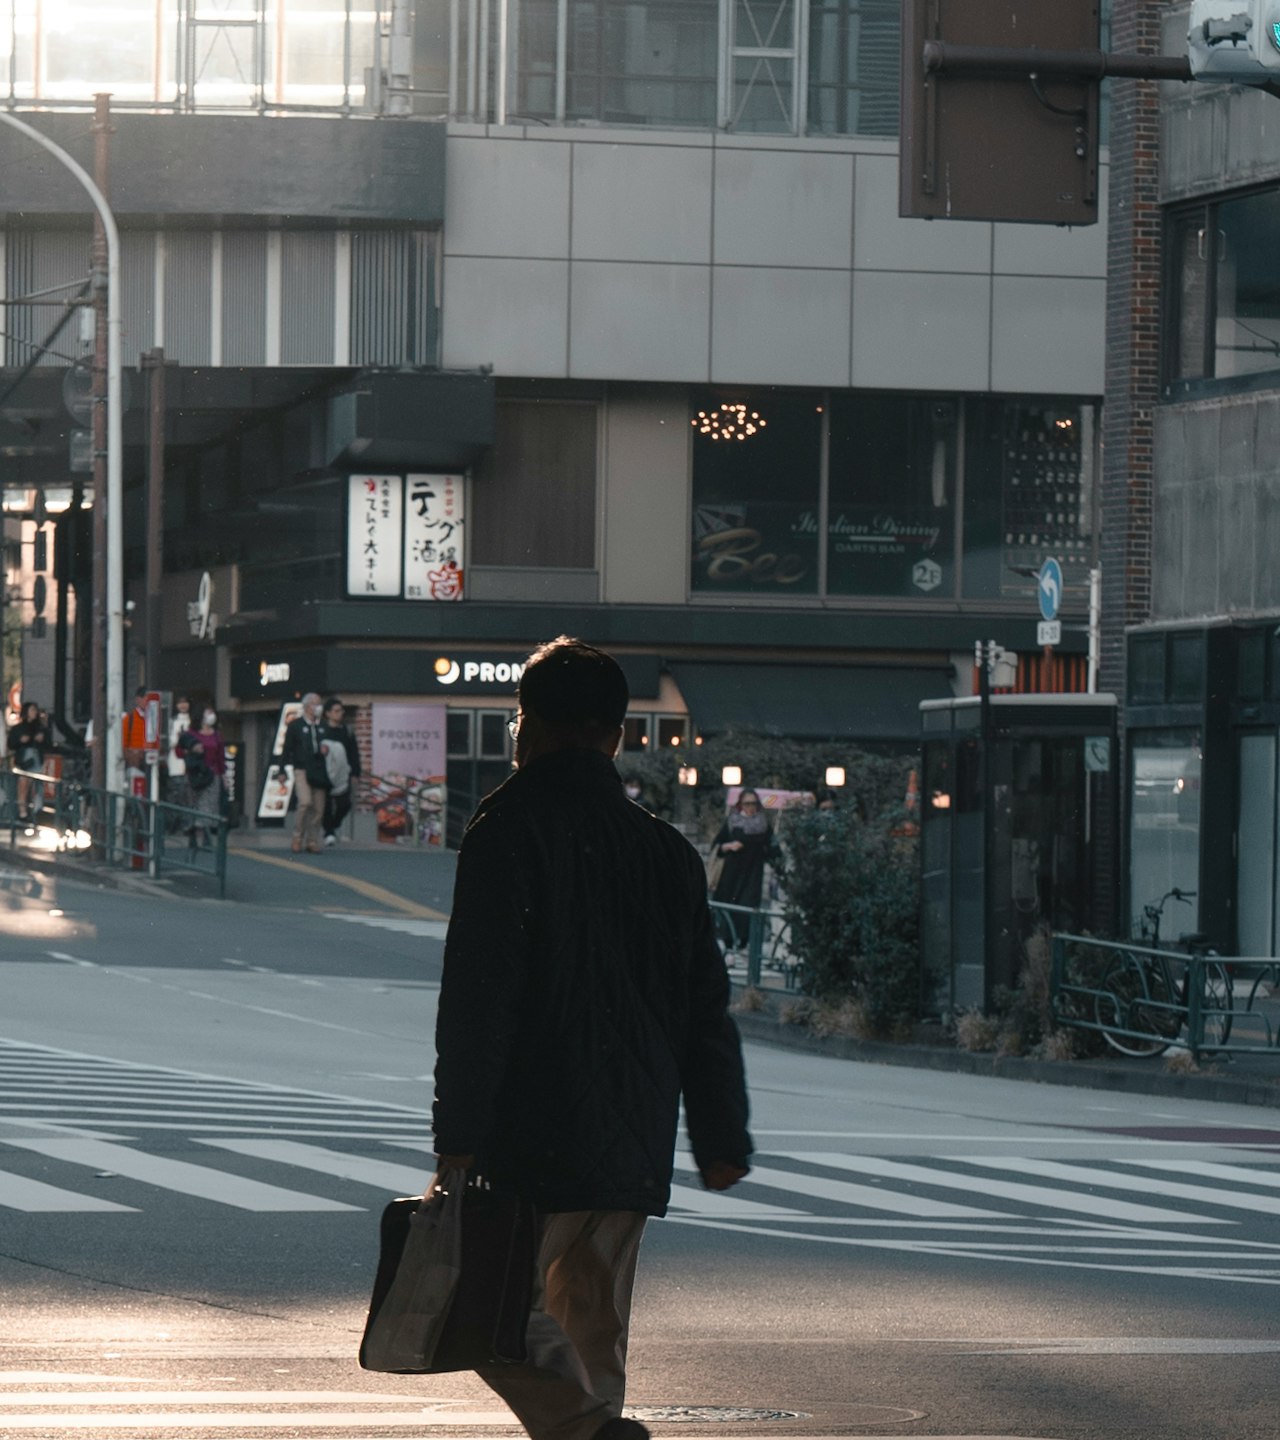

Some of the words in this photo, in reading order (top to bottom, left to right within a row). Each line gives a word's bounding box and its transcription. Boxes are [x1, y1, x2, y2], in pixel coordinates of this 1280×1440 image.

[872, 513, 940, 551] Dining
[463, 661, 525, 683] PRON
[378, 728, 441, 741] PRONTO'S
[390, 740, 430, 753] PASTA
